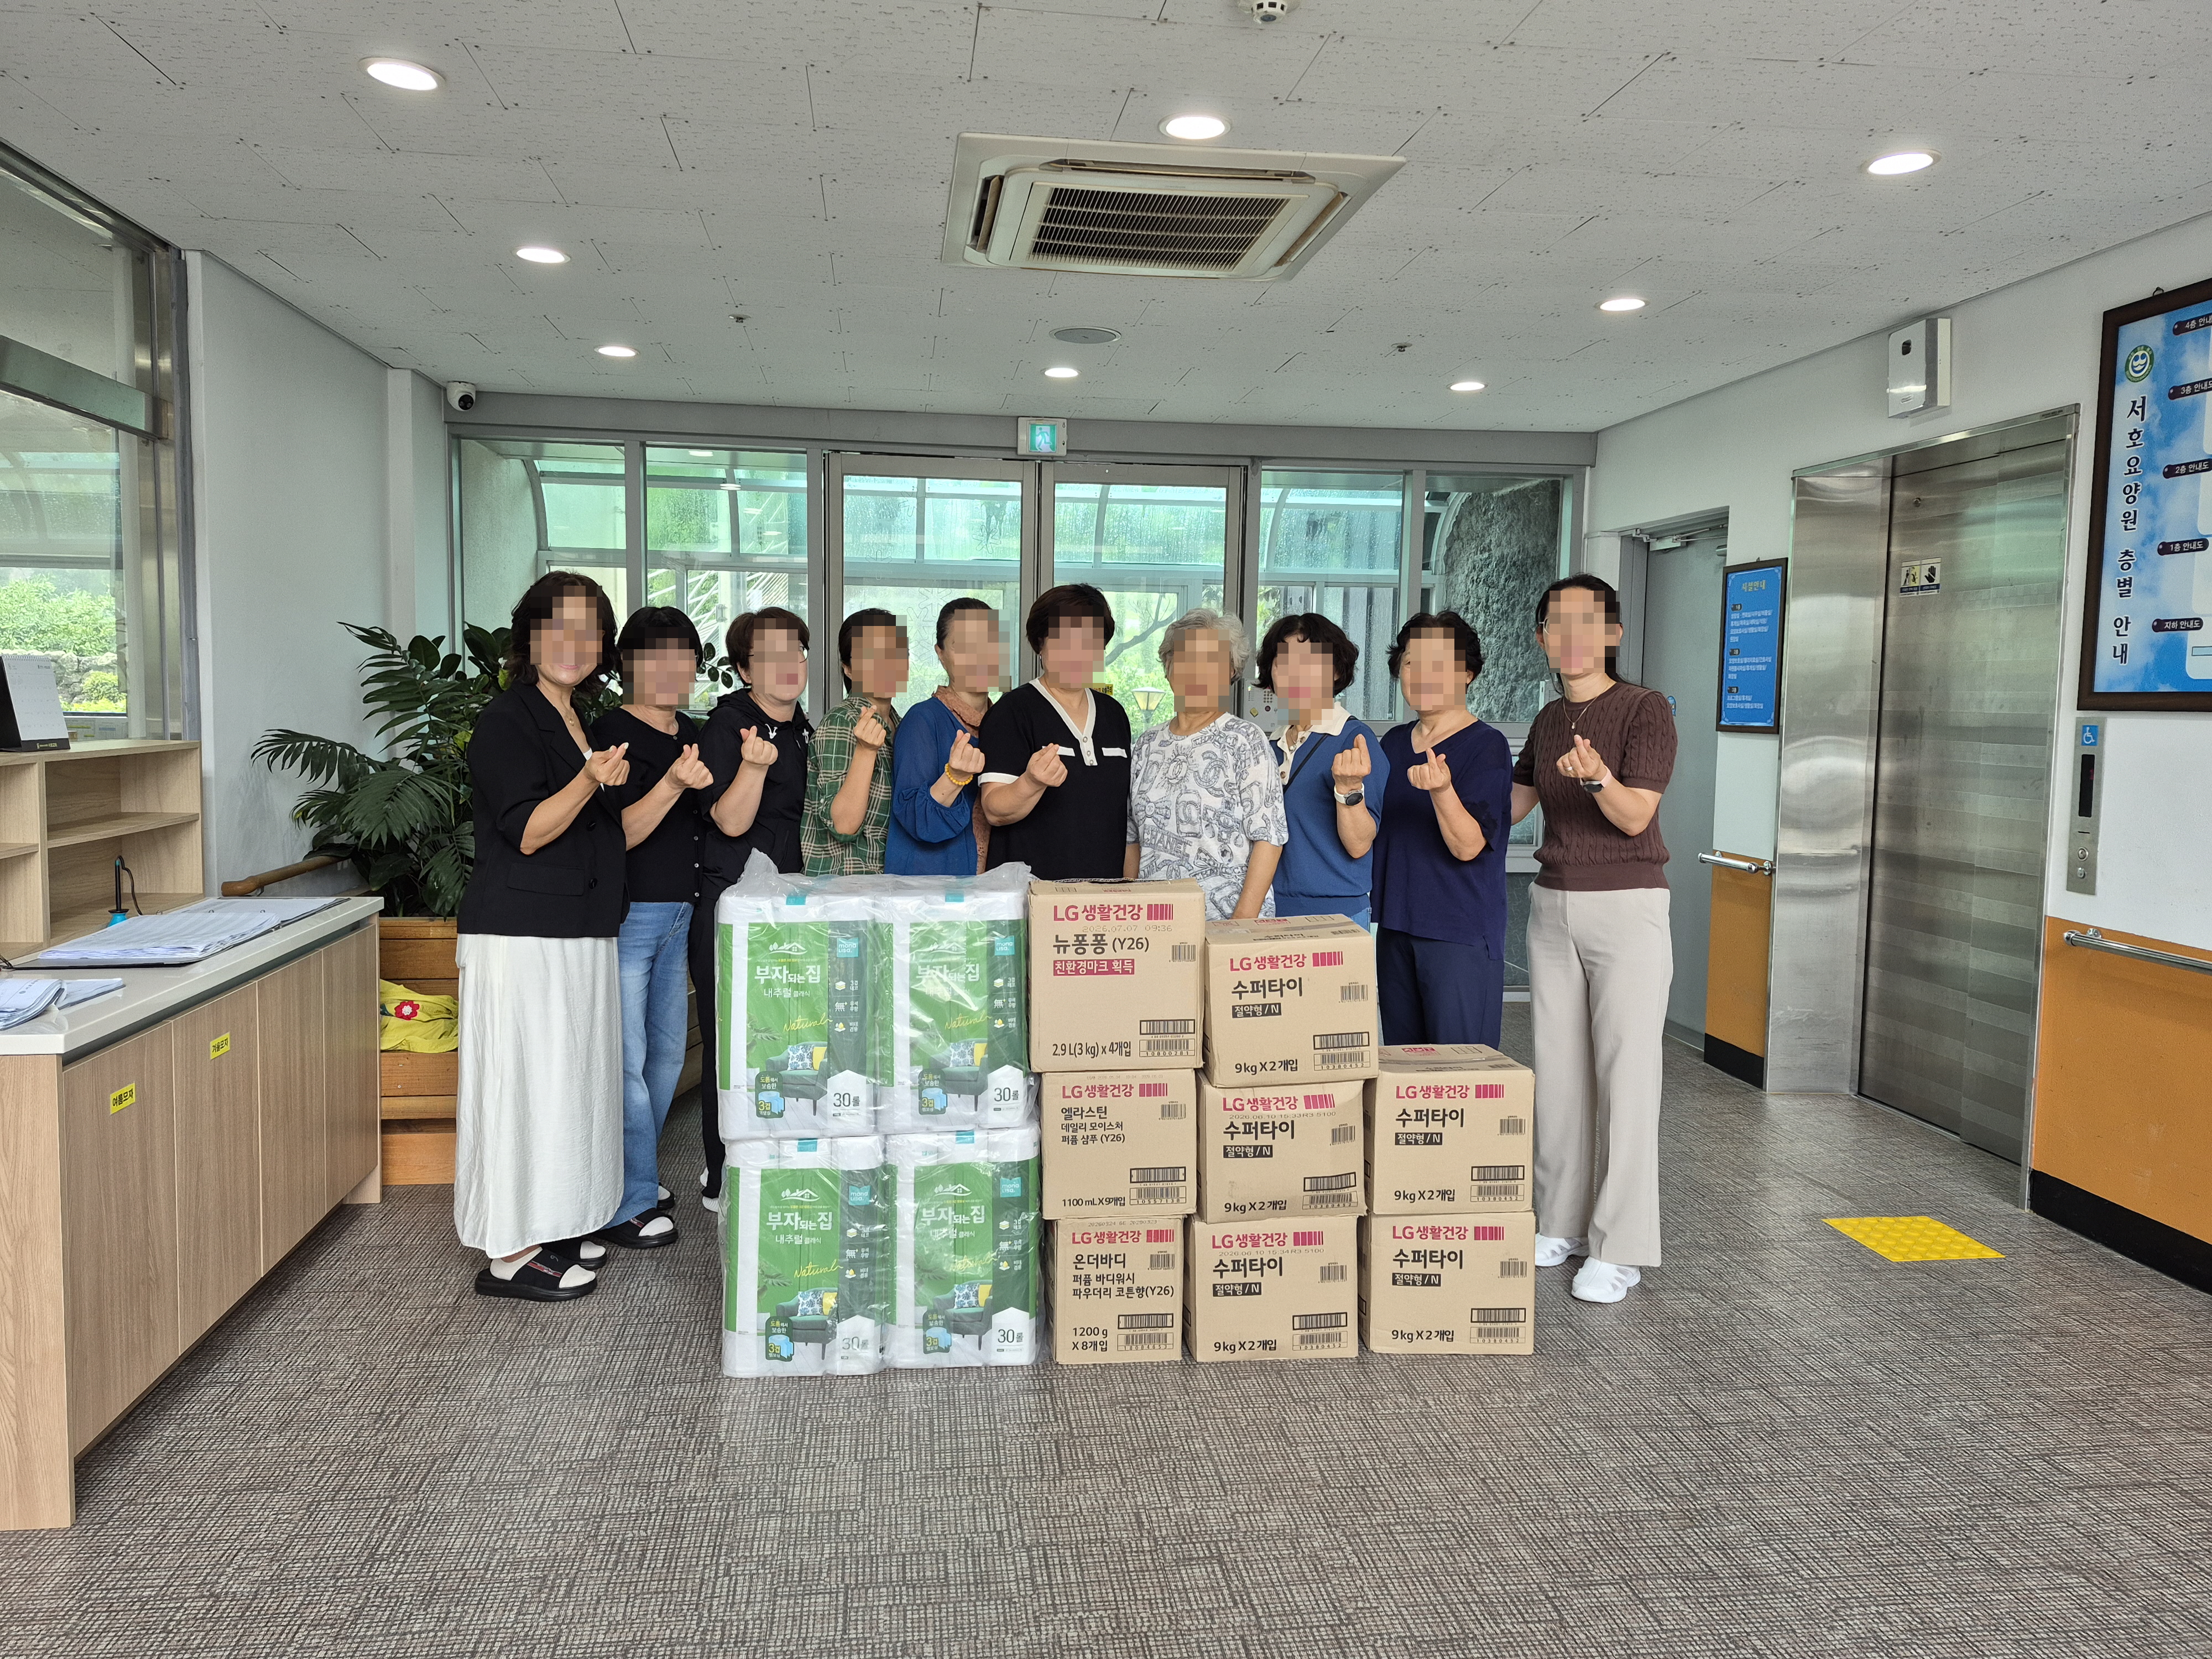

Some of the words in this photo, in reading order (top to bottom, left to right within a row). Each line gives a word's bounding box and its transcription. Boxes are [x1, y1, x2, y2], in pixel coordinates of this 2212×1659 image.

[2185, 319, 2197, 329] 4층
[2180, 385, 2192, 394] 3층
[2120, 395, 2147, 531] 서호요양원
[2175, 465, 2187, 474] 2층
[2188, 461, 2209, 472] 안내도
[2170, 542, 2181, 552] 1층
[2183, 541, 2203, 550] 안내도
[2116, 549, 2136, 598] 층별
[2164, 621, 2178, 629] 지하
[2180, 620, 2200, 629] 안내도
[2112, 616, 2131, 664] 안내
[1053, 933, 1108, 955] 뉴퐁퐁
[1112, 937, 1150, 953] (Y26)
[1055, 959, 1109, 975] 친환경마크
[1112, 959, 1134, 974] 획득
[764, 987, 791, 998] 내추럴
[1232, 977, 1302, 1000] 수퍼타이
[783, 1013, 833, 1032] Natural
[945, 1009, 992, 1030] Natural
[212, 1037, 228, 1053] 겨울모자
[1109, 1041, 1131, 1057] 4개입
[112, 1088, 133, 1107] 여름모자
[758, 1100, 771, 1111] 3겹
[922, 1098, 934, 1107] 3겹
[1061, 1105, 1108, 1120] 엘라스틴
[1395, 1108, 1464, 1128] 수퍼타이
[1061, 1122, 1087, 1133] 데일리
[1089, 1121, 1123, 1132] 모이스처
[1223, 1120, 1295, 1140] 수퍼타이
[1061, 1135, 1078, 1145] 퍼퓸
[1081, 1134, 1098, 1145] 샴푸
[1100, 1133, 1125, 1144] (Y26)
[775, 1234, 803, 1244] 내추럴
[1073, 1253, 1126, 1270] 온더바디
[1392, 1249, 1463, 1269] 수퍼타이
[794, 1259, 844, 1278] Natural
[1213, 1256, 1283, 1279] 수퍼타이
[1072, 1274, 1092, 1286] 퍼퓸
[1095, 1272, 1135, 1285] 바디워시
[1072, 1287, 1112, 1300] 파우더리
[1115, 1285, 1174, 1298] 코튼향(Y26)
[768, 1343, 780, 1353] 3겹
[926, 1337, 938, 1347] 3겹
